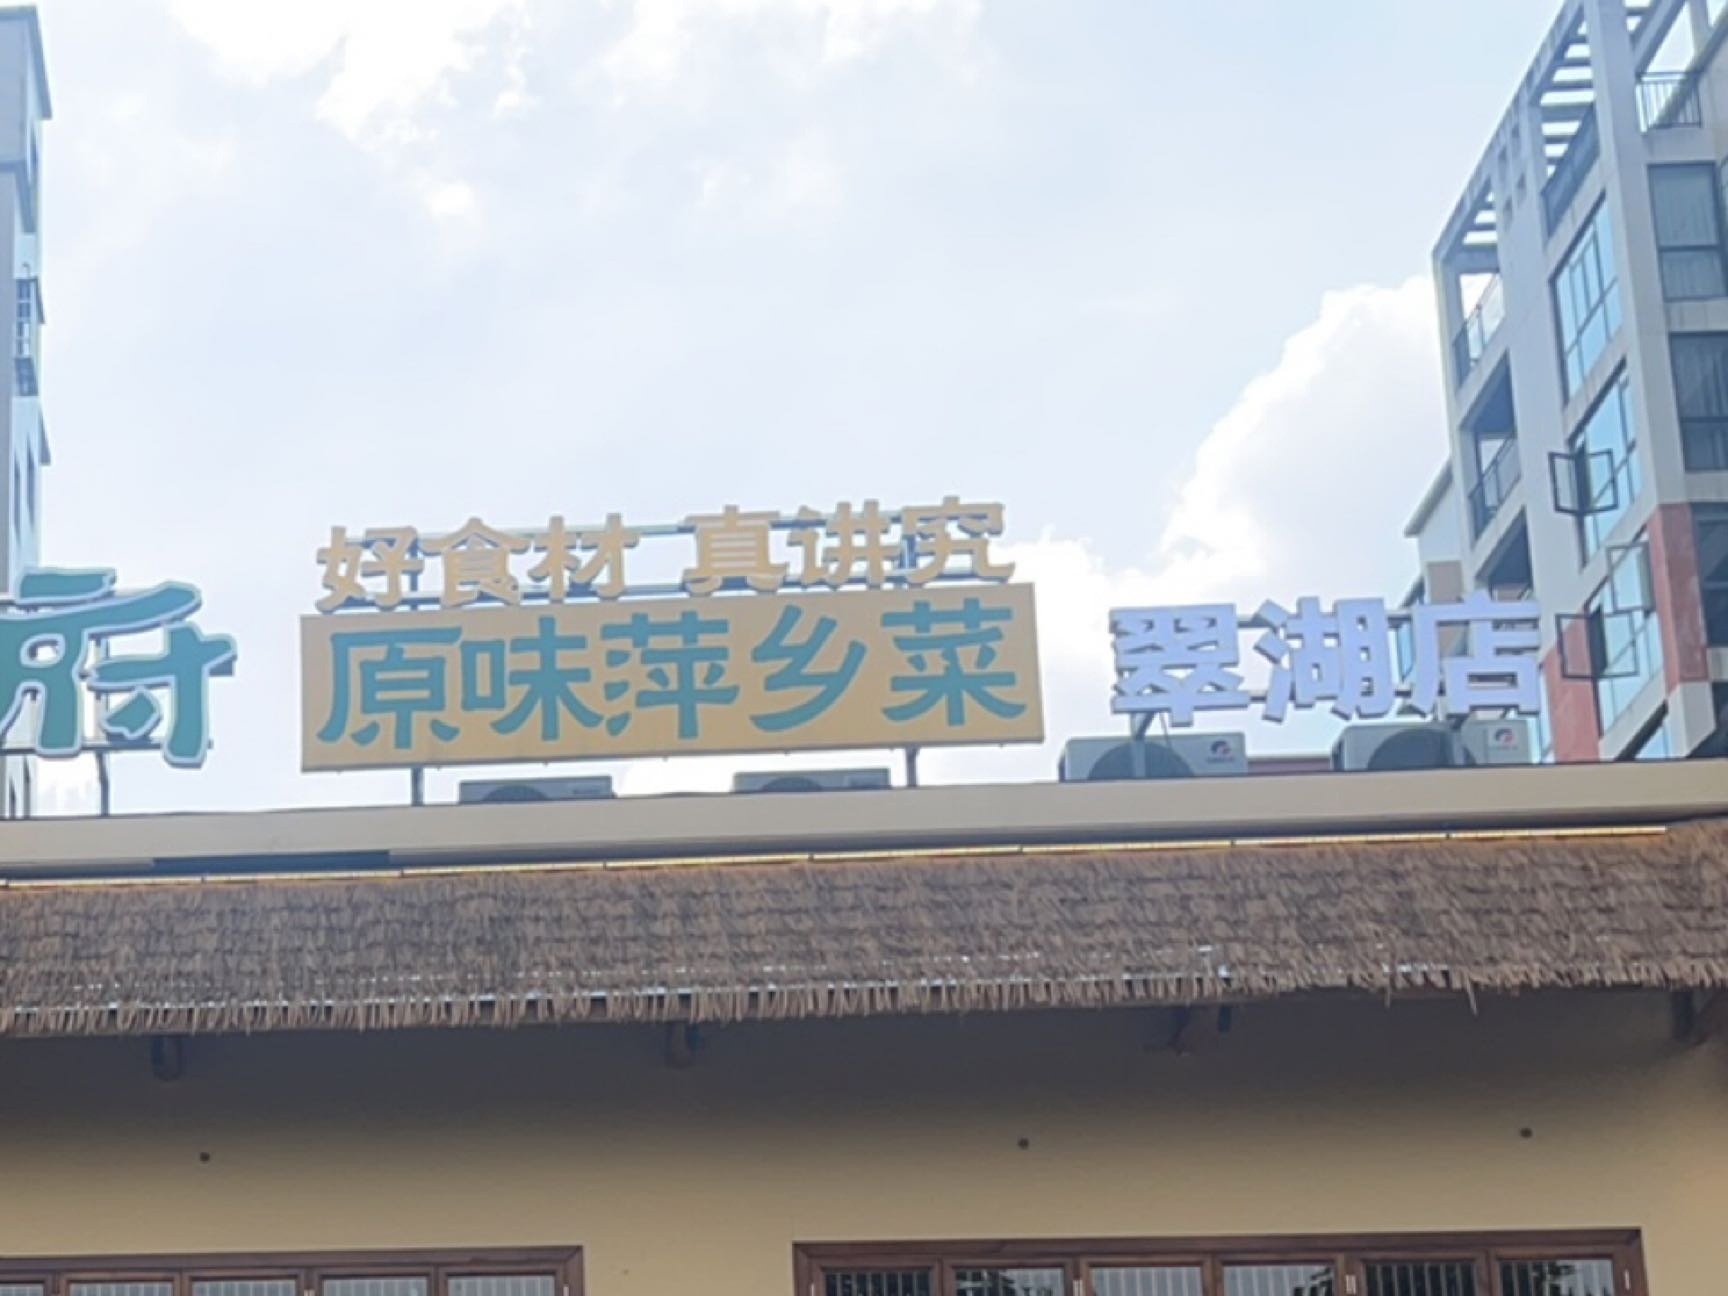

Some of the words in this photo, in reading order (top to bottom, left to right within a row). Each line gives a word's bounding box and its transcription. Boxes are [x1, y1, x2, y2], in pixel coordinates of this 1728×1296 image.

[315, 514, 638, 612] 好食材
[682, 498, 1015, 590] 真讲究
[316, 601, 1028, 750] 原味萍乡菜
[1110, 596, 1544, 726] 翠湖店
